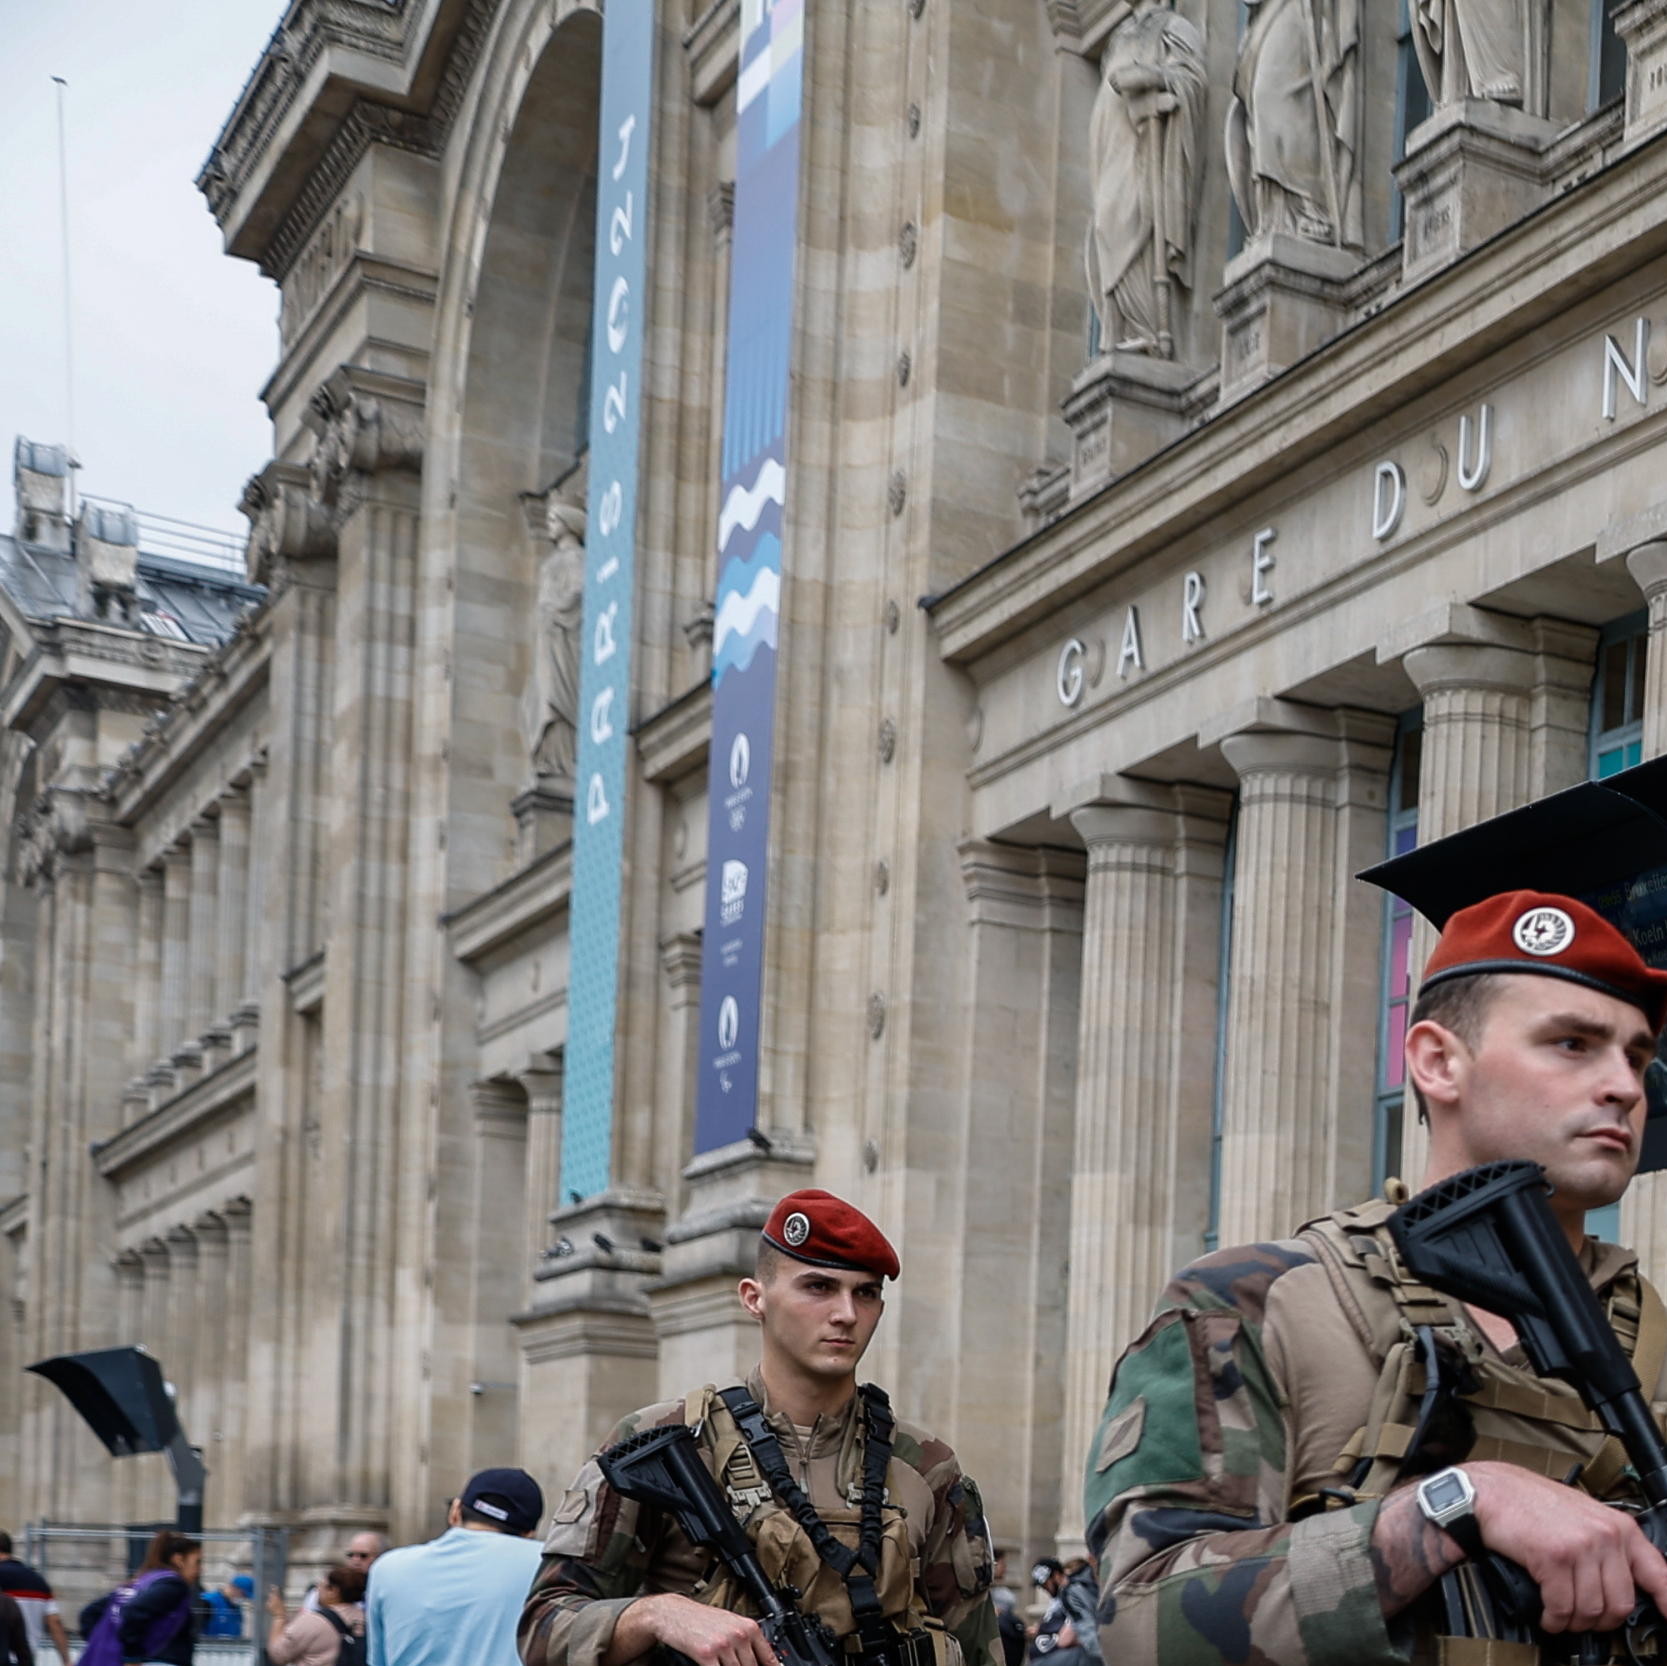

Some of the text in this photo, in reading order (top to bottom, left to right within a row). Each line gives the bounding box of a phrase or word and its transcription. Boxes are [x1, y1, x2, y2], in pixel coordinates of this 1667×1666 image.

[587, 480, 622, 825] PARIS
[1056, 527, 1277, 707] GARE
[1371, 403, 1493, 542] DU
